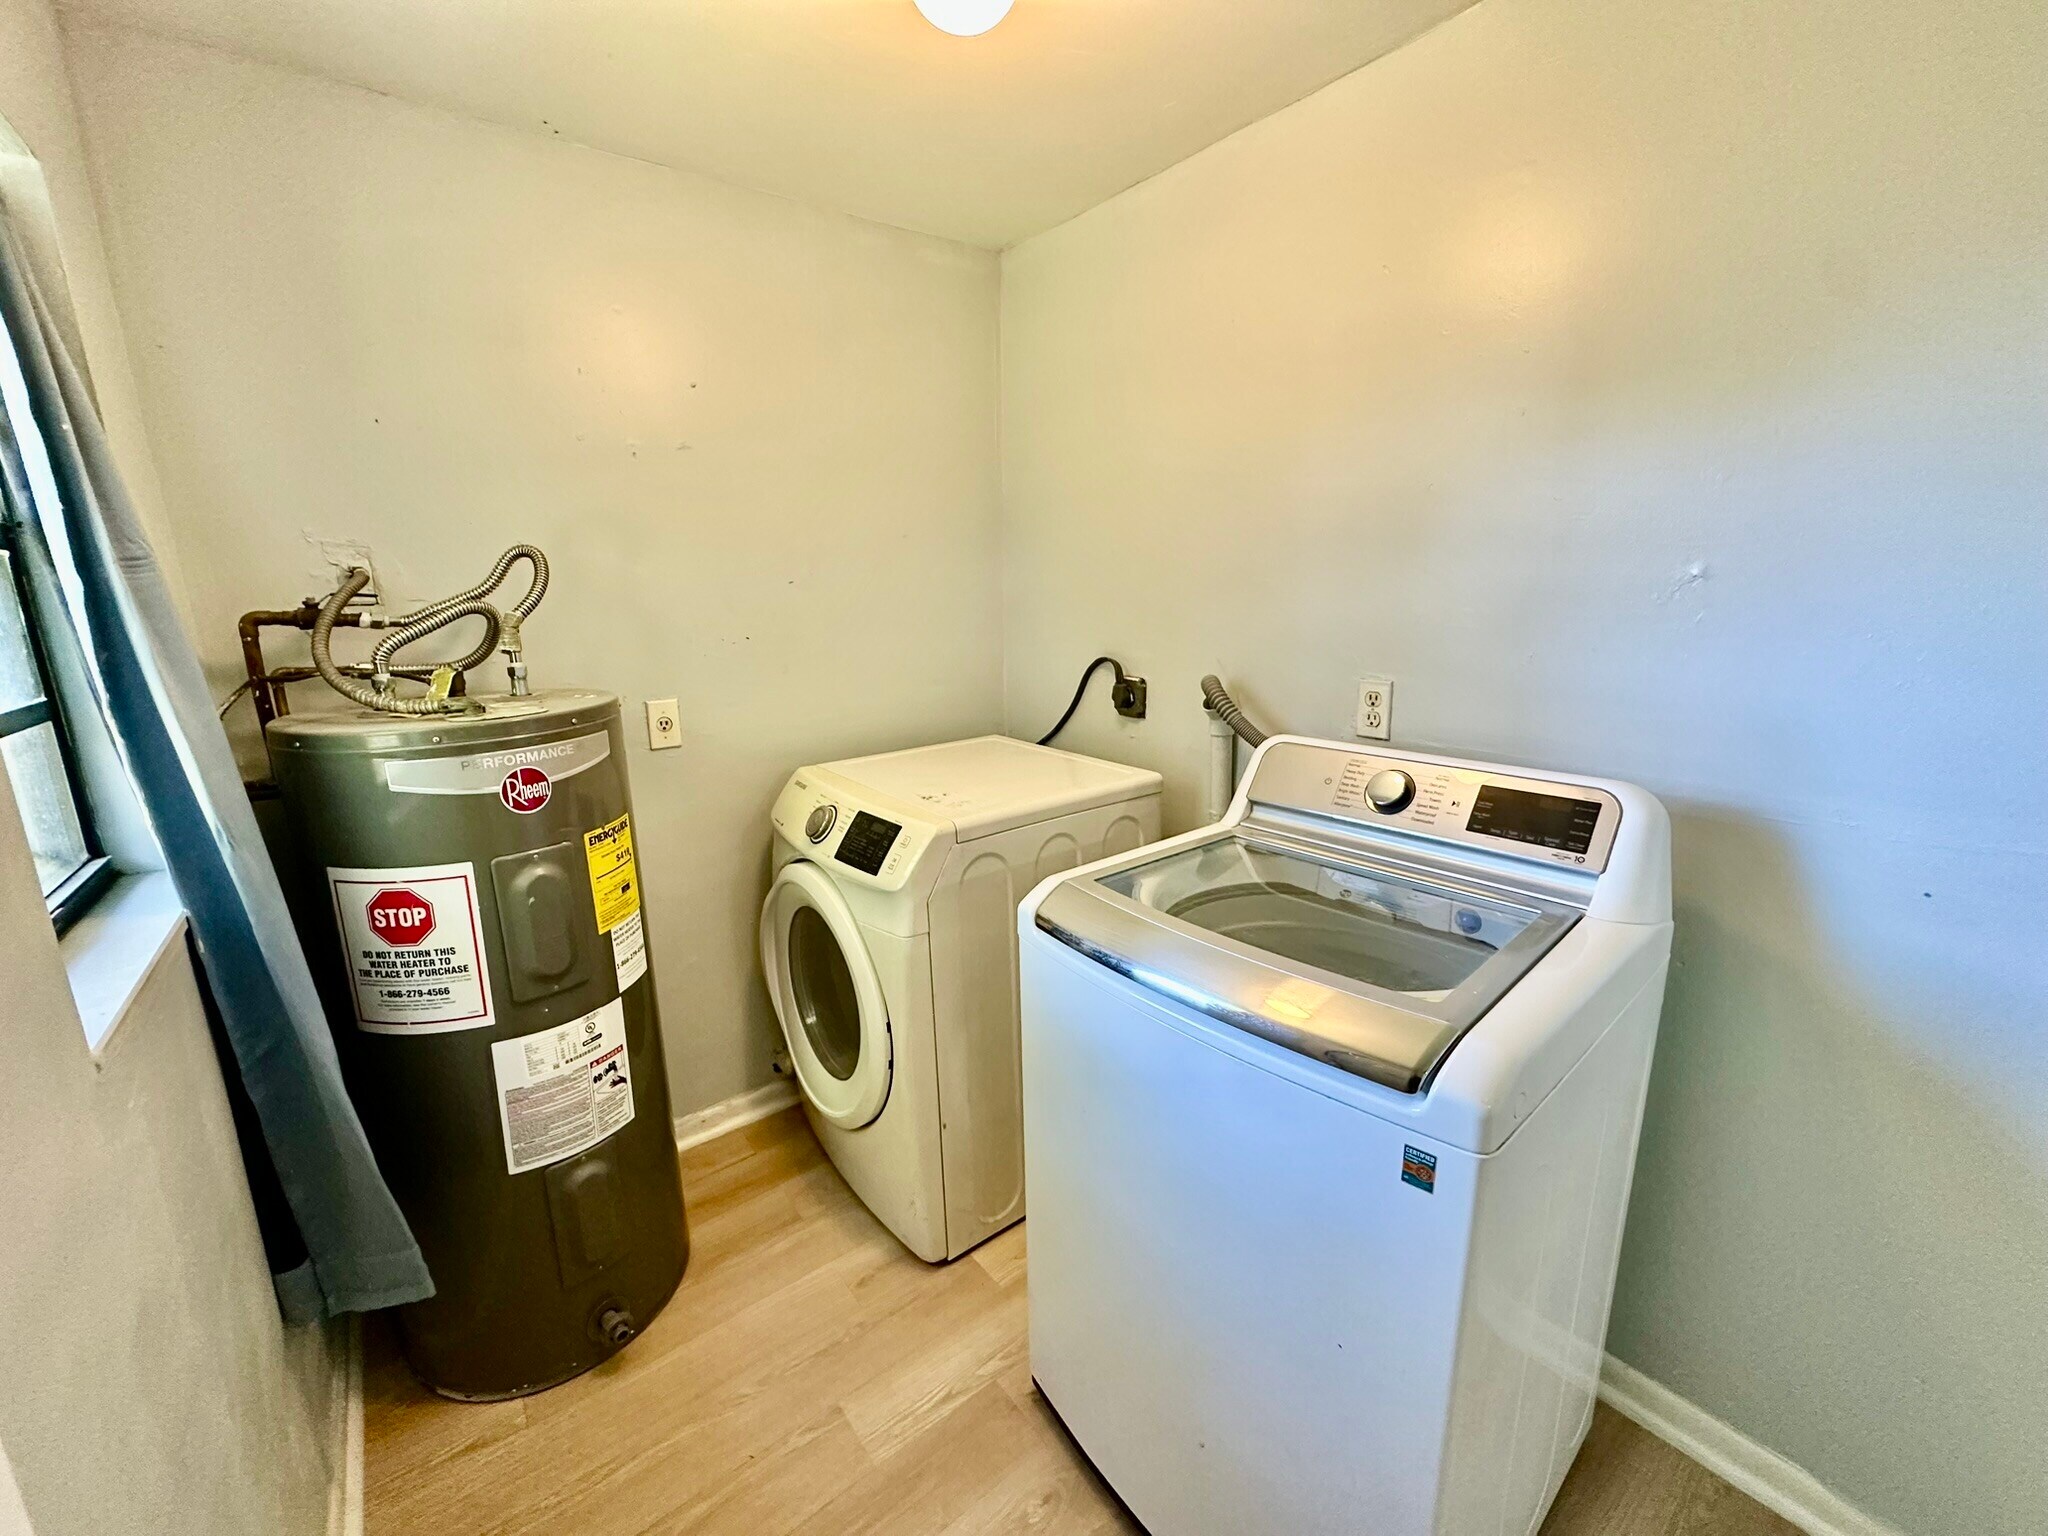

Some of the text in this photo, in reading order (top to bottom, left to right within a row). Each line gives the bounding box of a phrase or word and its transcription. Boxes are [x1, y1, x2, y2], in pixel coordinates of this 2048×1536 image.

[505, 768, 550, 807] Rheem
[373, 907, 427, 928] STOP
[362, 947, 456, 960] DO NOT RETURN THIS
[368, 957, 451, 969] WATER HEATER TO
[358, 964, 470, 979] THE PLACE OF PURCHASE
[378, 987, 450, 999] 1-866-279-4566
